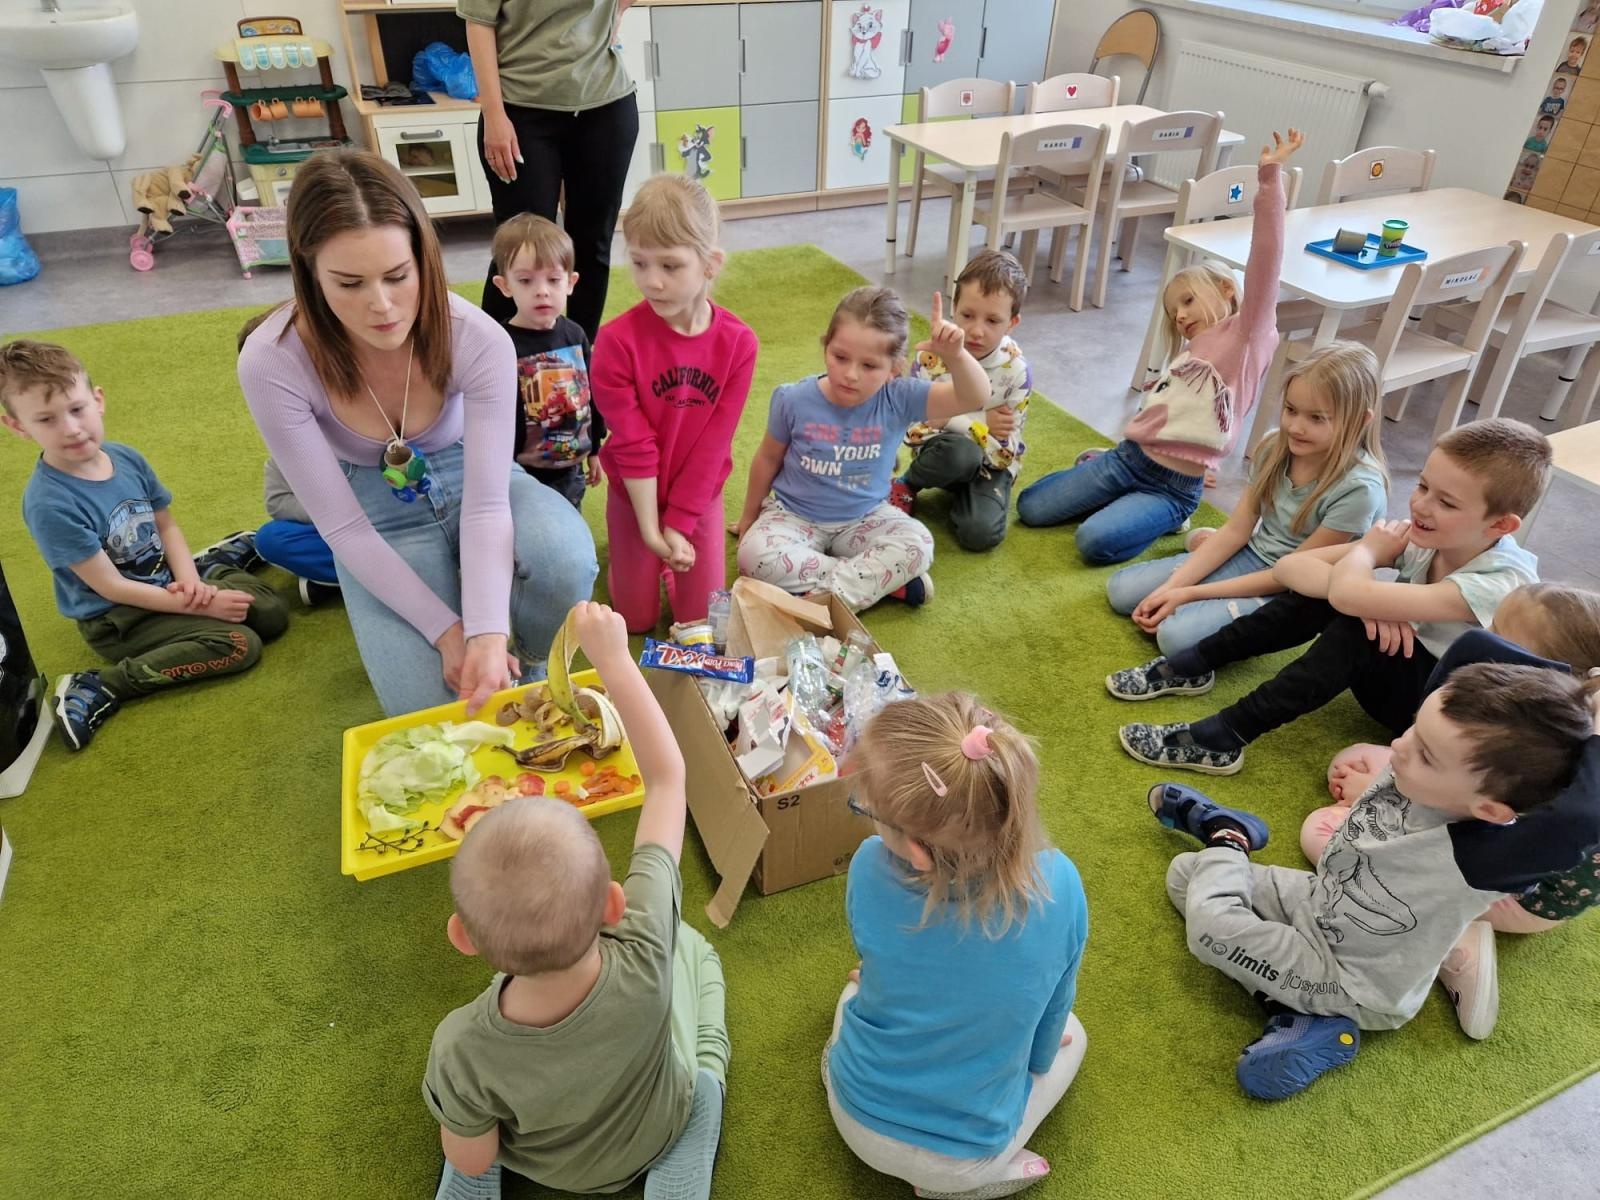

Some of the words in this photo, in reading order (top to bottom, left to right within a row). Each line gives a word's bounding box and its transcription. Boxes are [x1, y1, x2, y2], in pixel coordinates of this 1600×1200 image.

[652, 366, 720, 404] CALIFORNIA
[833, 443, 881, 461] YOUR
[801, 455, 842, 476] OWN
[656, 645, 706, 670] XXL
[777, 794, 801, 810] S2
[1227, 945, 1280, 981] limits
